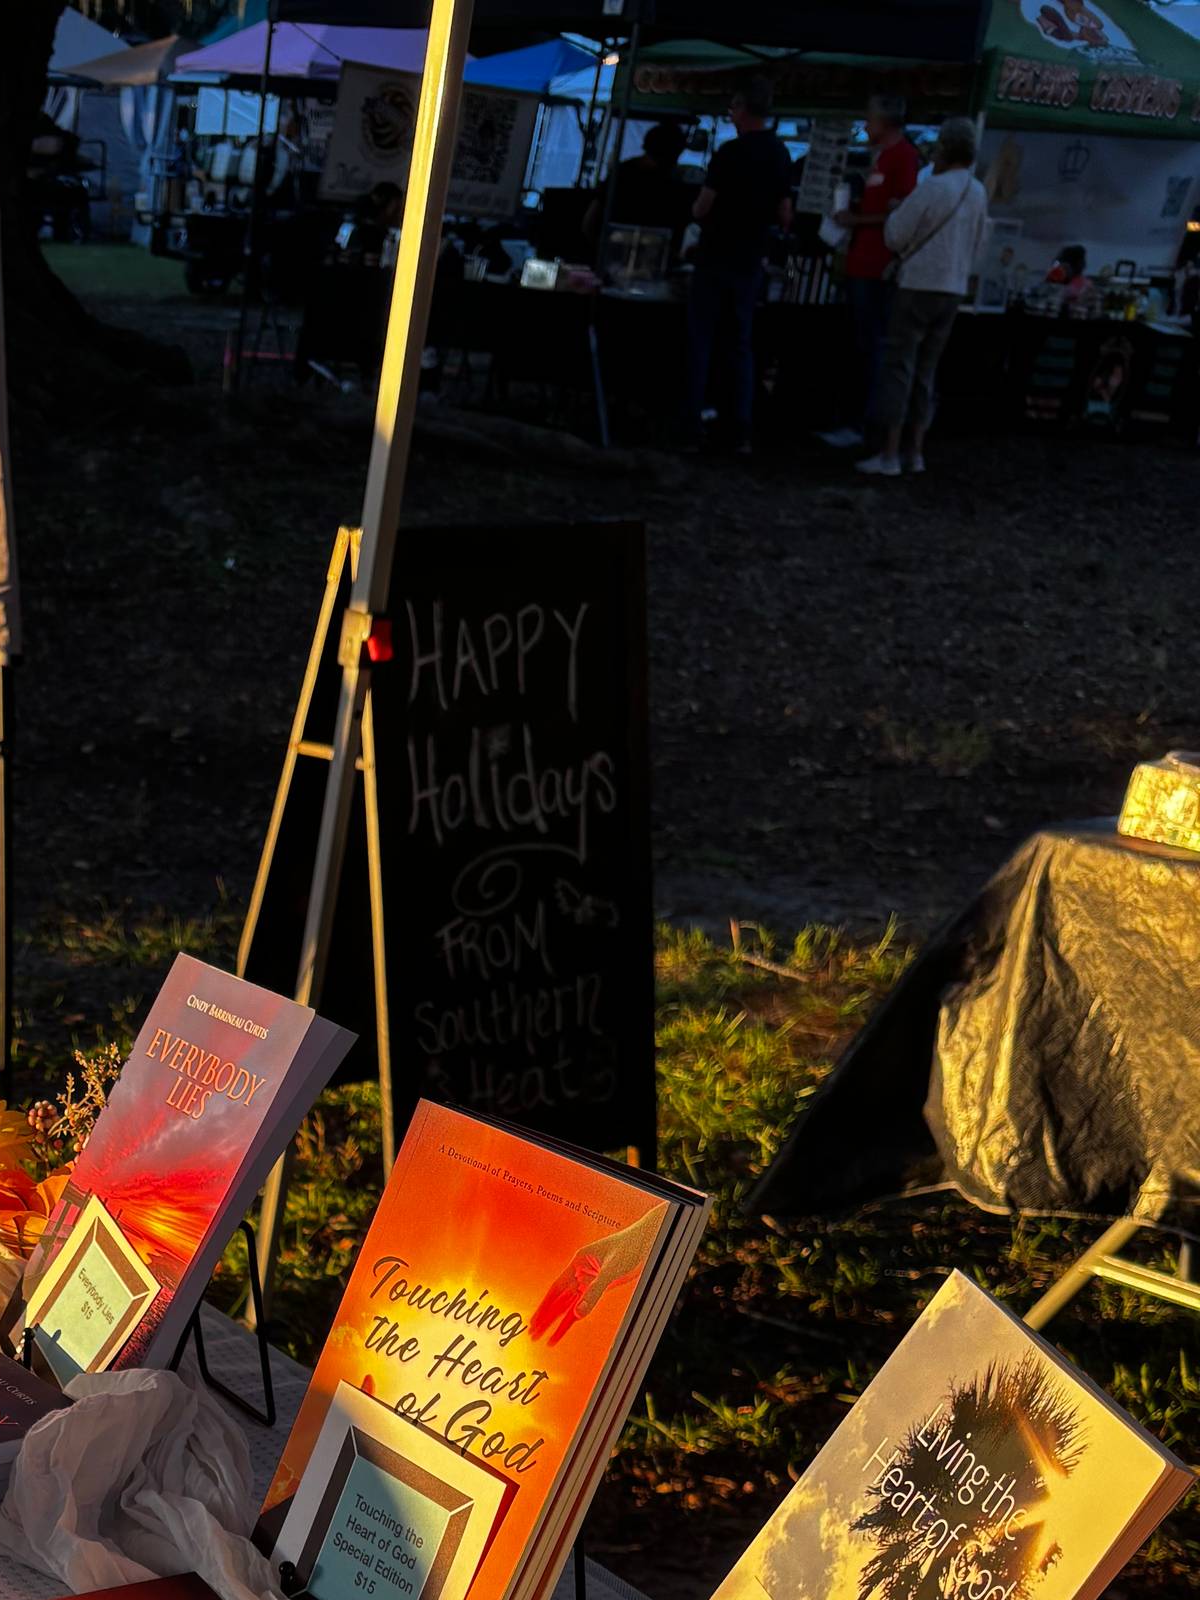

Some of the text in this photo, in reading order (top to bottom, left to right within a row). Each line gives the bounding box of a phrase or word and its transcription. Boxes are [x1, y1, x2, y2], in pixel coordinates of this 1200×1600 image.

[405, 594, 590, 722] HAPPY
[407, 722, 616, 866] Holidays
[433, 897, 553, 982] FROM
[186, 993, 269, 1041] CINDY BARRINEAU CURTIS
[145, 1028, 267, 1108] EVERYBODY
[166, 1076, 214, 1120] LIES
[438, 1143, 622, 1230] A Devotional of Prayers, Poems and Scripture
[77, 1267, 116, 1325] Everybody Lies
[80, 1300, 93, 1321] $15
[369, 1255, 531, 1346] Touching
[362, 1314, 550, 1407] the Heart
[394, 1391, 546, 1475] of God
[917, 1403, 1034, 1541] Living the
[354, 1492, 425, 1549] Touching the
[862, 1437, 937, 1531] Heart
[926, 1512, 960, 1559] of
[333, 1532, 416, 1596] Special Edition
[344, 1513, 417, 1571] Heart of God
[354, 1572, 376, 1595] $15
